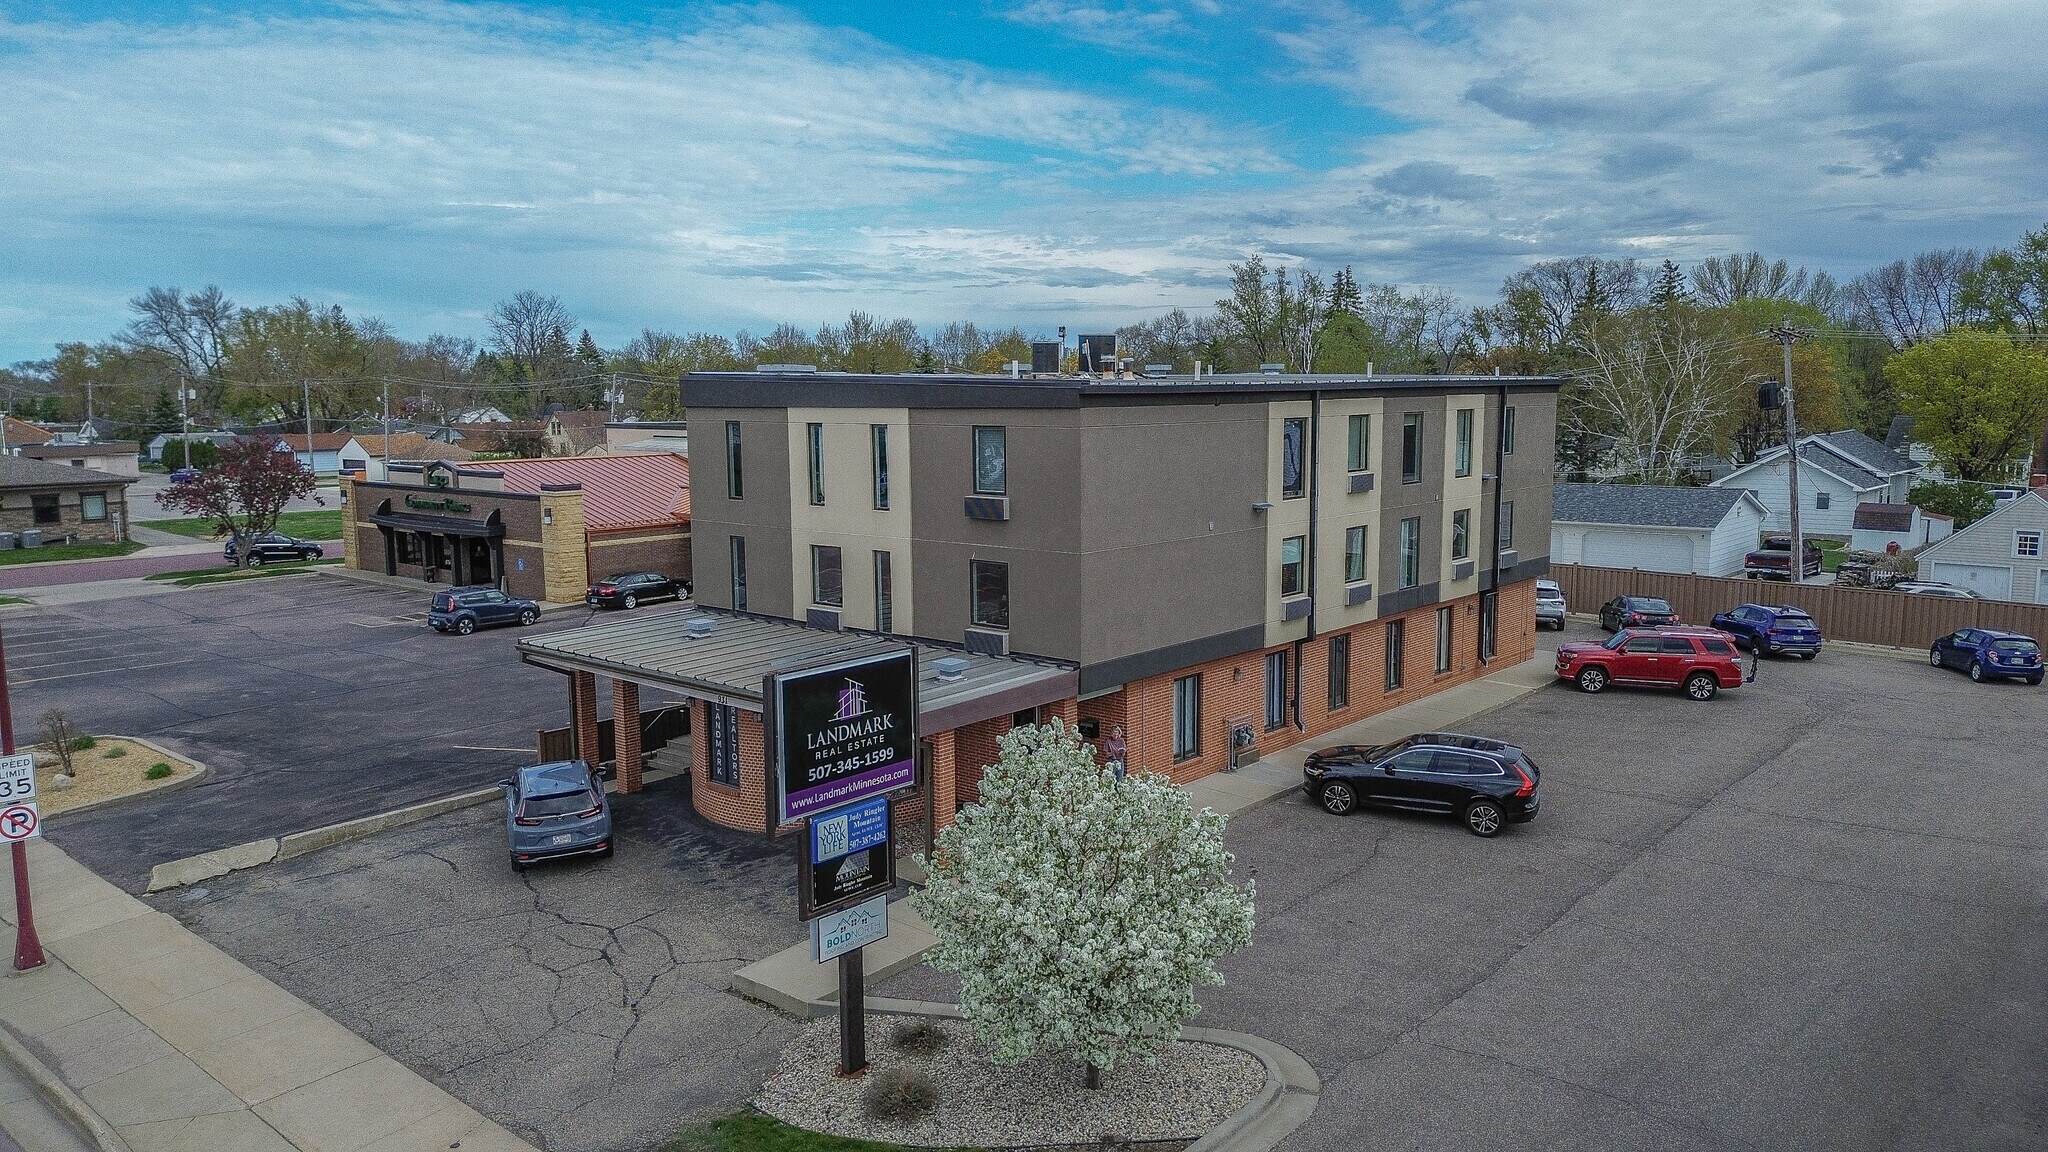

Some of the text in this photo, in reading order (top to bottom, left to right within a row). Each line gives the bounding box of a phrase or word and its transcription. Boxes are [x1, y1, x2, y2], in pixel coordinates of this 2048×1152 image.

[718, 695, 727, 704] 931
[715, 703, 723, 776] LANDMARK
[807, 713, 895, 750] LANDMARK
[730, 706, 738, 780] REALTORS
[815, 734, 886, 760] REAL ESTATE
[0, 759, 31, 770] PEED
[0, 768, 27, 780] LIMIT
[808, 747, 895, 782] 507-345-1599
[0, 777, 31, 798] 35
[791, 767, 910, 810] www.LandmarkMinnesota.com
[823, 819, 845, 834] NEW
[819, 829, 847, 846] YORK
[823, 842, 844, 855] LIFE
